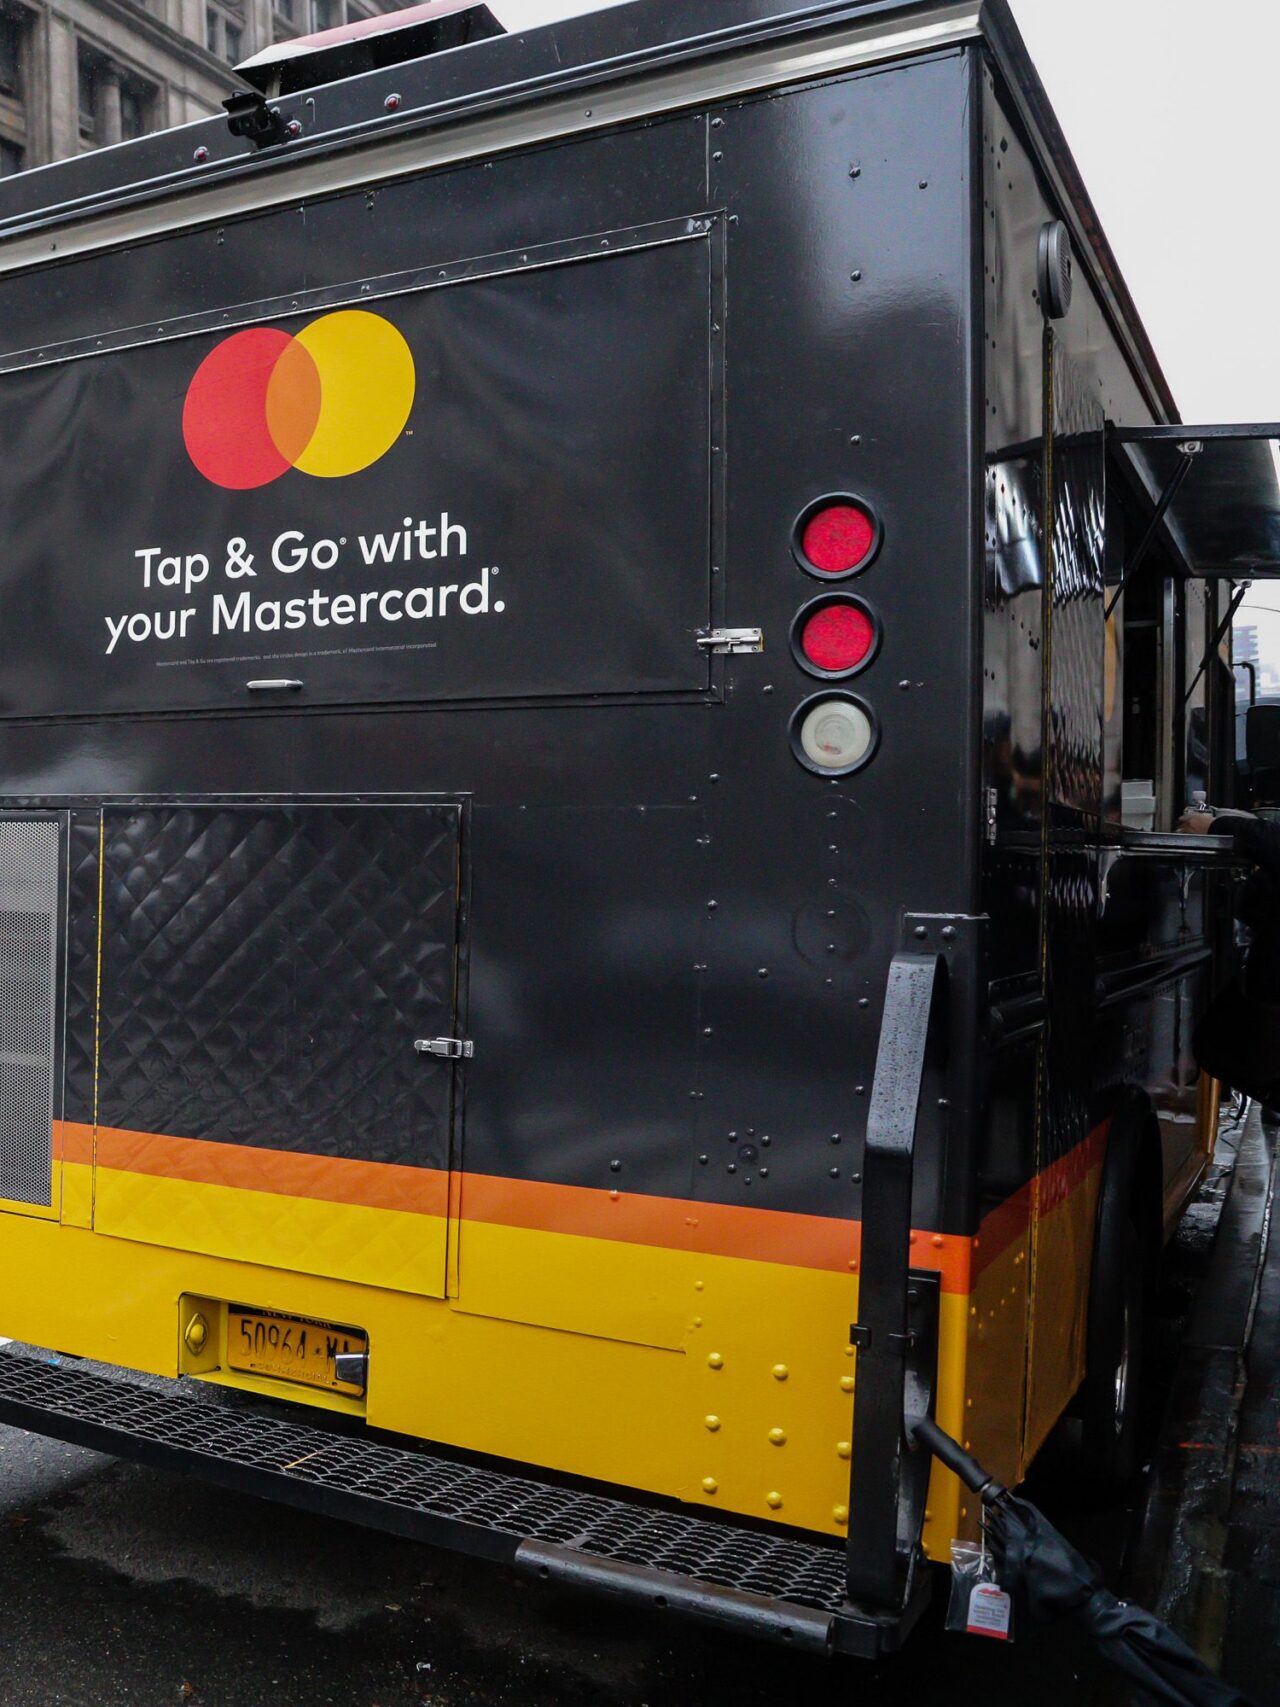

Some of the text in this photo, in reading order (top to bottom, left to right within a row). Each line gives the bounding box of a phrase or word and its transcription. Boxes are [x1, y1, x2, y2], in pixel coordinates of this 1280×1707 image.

[134, 547, 210, 595] Tap
[224, 536, 258, 579] &
[357, 511, 467, 565] with
[104, 607, 197, 655] your
